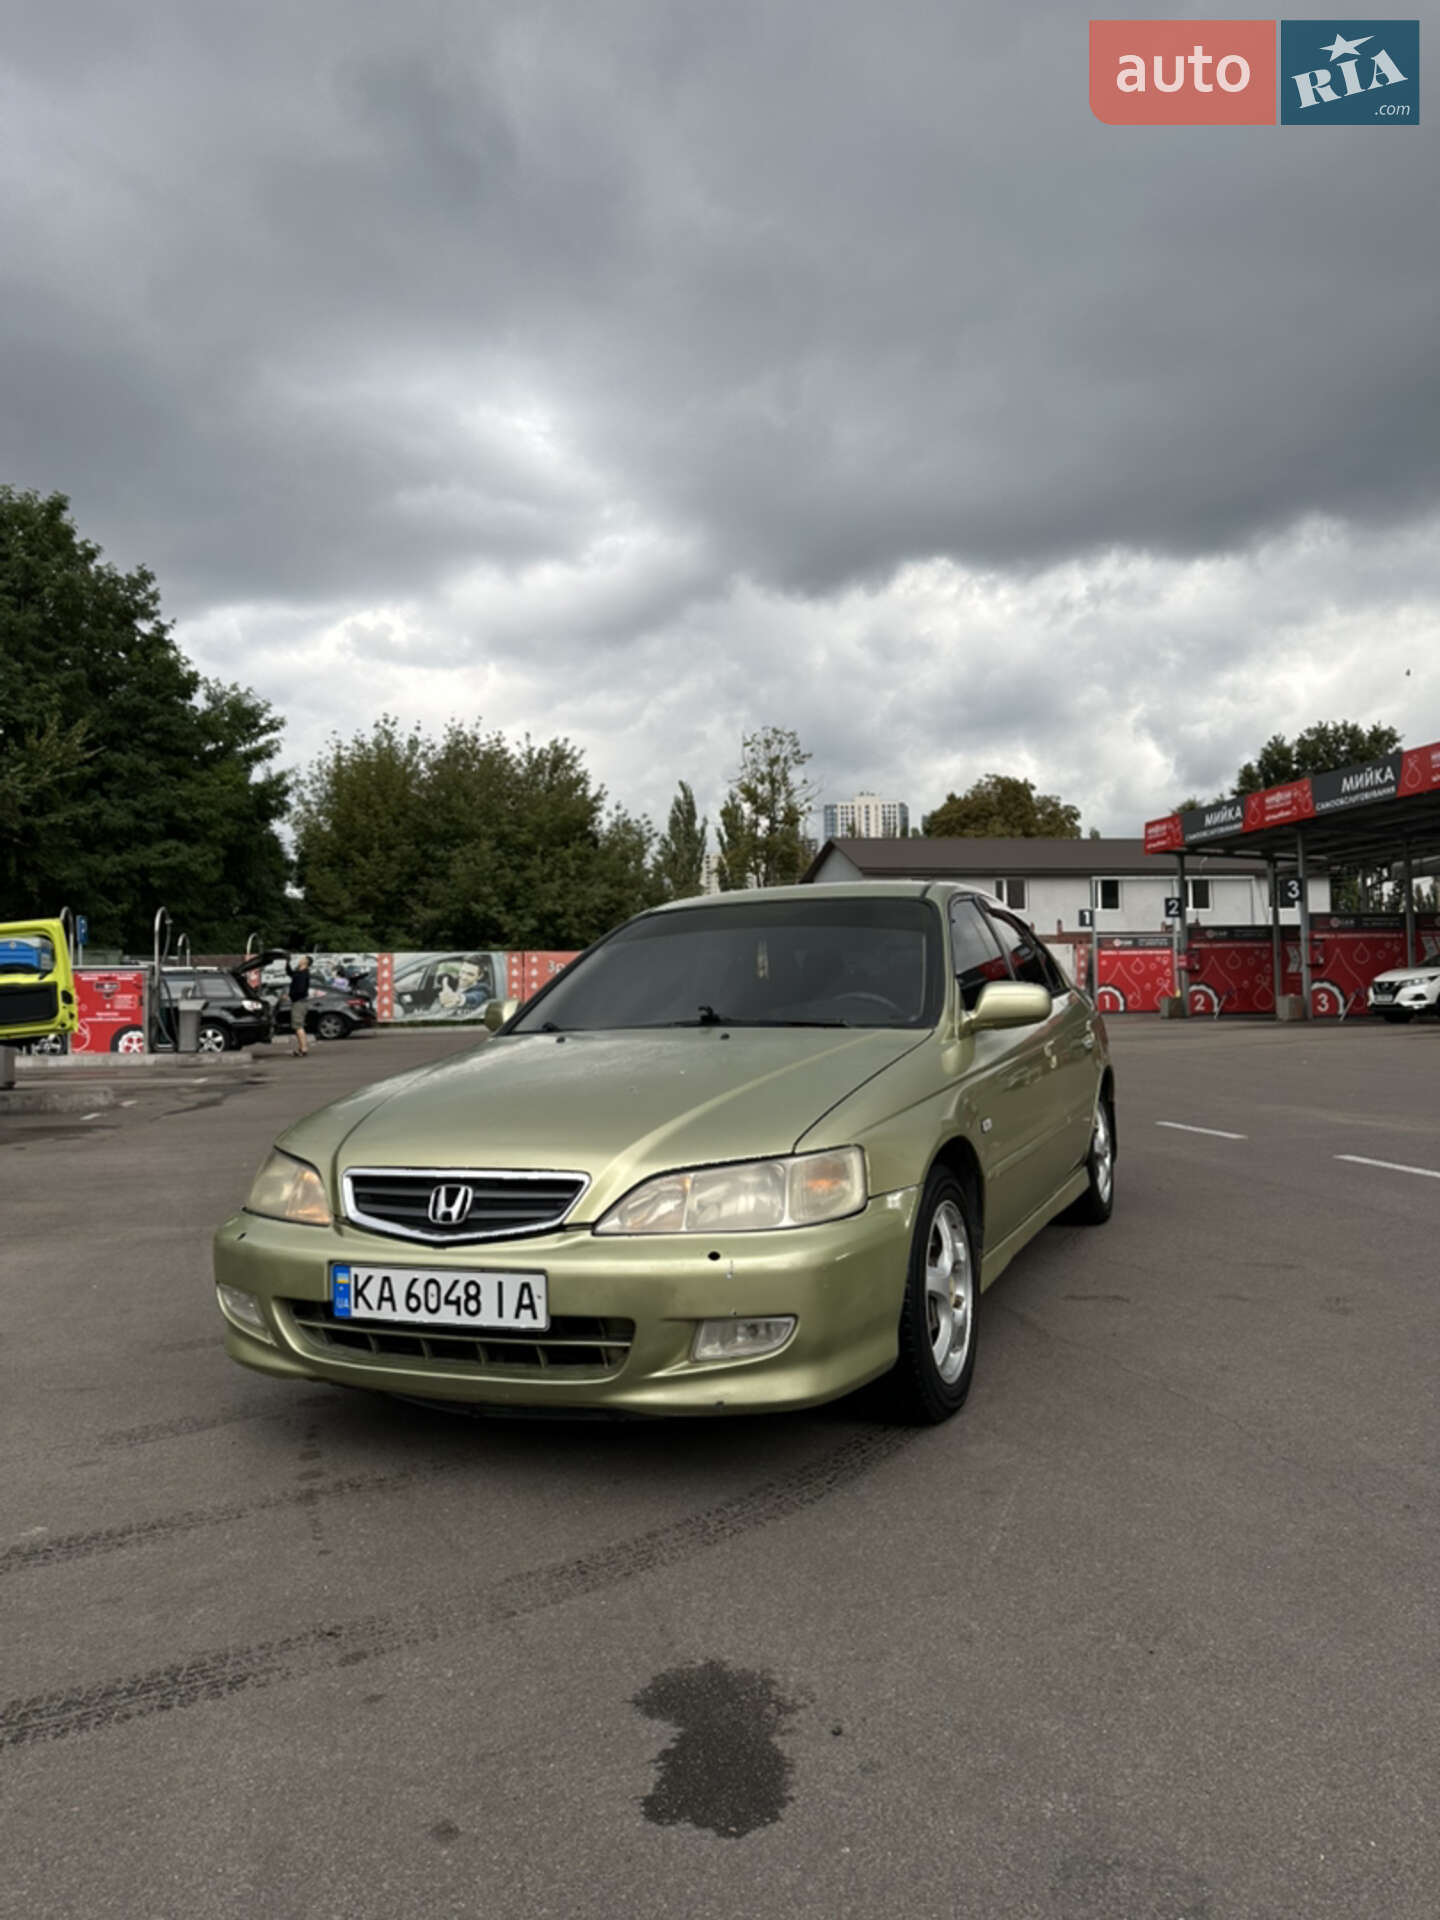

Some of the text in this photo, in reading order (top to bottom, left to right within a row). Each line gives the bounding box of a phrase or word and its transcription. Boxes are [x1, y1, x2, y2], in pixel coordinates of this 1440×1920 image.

[1341, 765, 1396, 793] МИЙКА
[1204, 804, 1243, 828] МИЙКА
[1287, 880, 1300, 899] 3
[1168, 899, 1179, 916] 2
[1083, 911, 1091, 925] 1
[1104, 994, 1111, 1009] 1
[1194, 994, 1205, 1010] 2
[1317, 993, 1329, 1012] 3
[353, 1274, 539, 1321] KA 6048 IA
